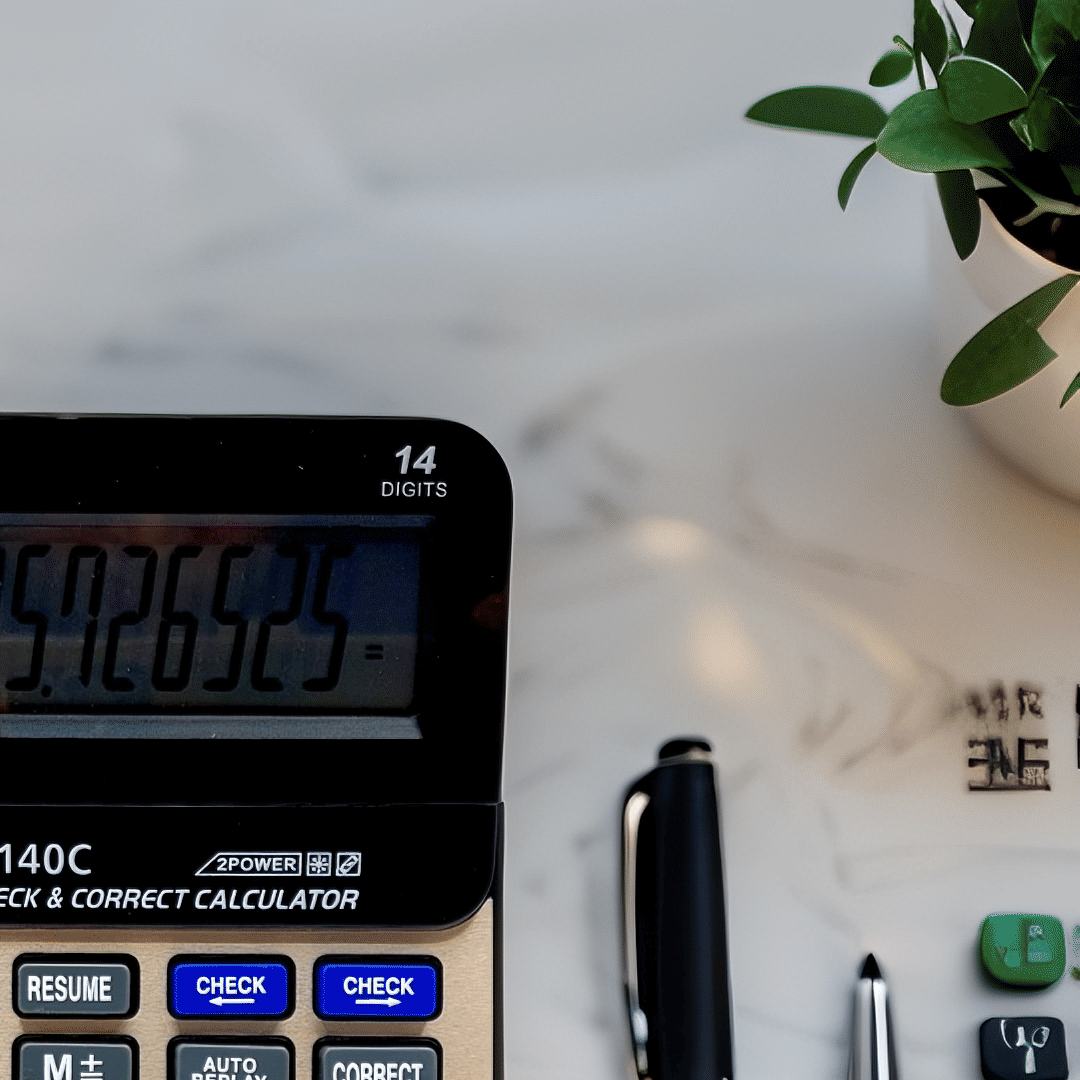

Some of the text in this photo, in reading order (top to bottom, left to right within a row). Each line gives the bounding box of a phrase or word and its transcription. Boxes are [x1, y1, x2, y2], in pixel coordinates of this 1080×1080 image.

[395, 445, 437, 475] 14
[381, 481, 448, 498] DIGITS
[216, 857, 297, 872] 2POWER
[47, 887, 64, 909] &
[71, 888, 190, 910] CORRECT
[194, 889, 360, 910] CALCULATOR
[27, 975, 112, 1002] RESUME
[196, 976, 267, 995] CHECK
[343, 977, 415, 996] CHECK
[203, 1057, 257, 1073] AUTO
